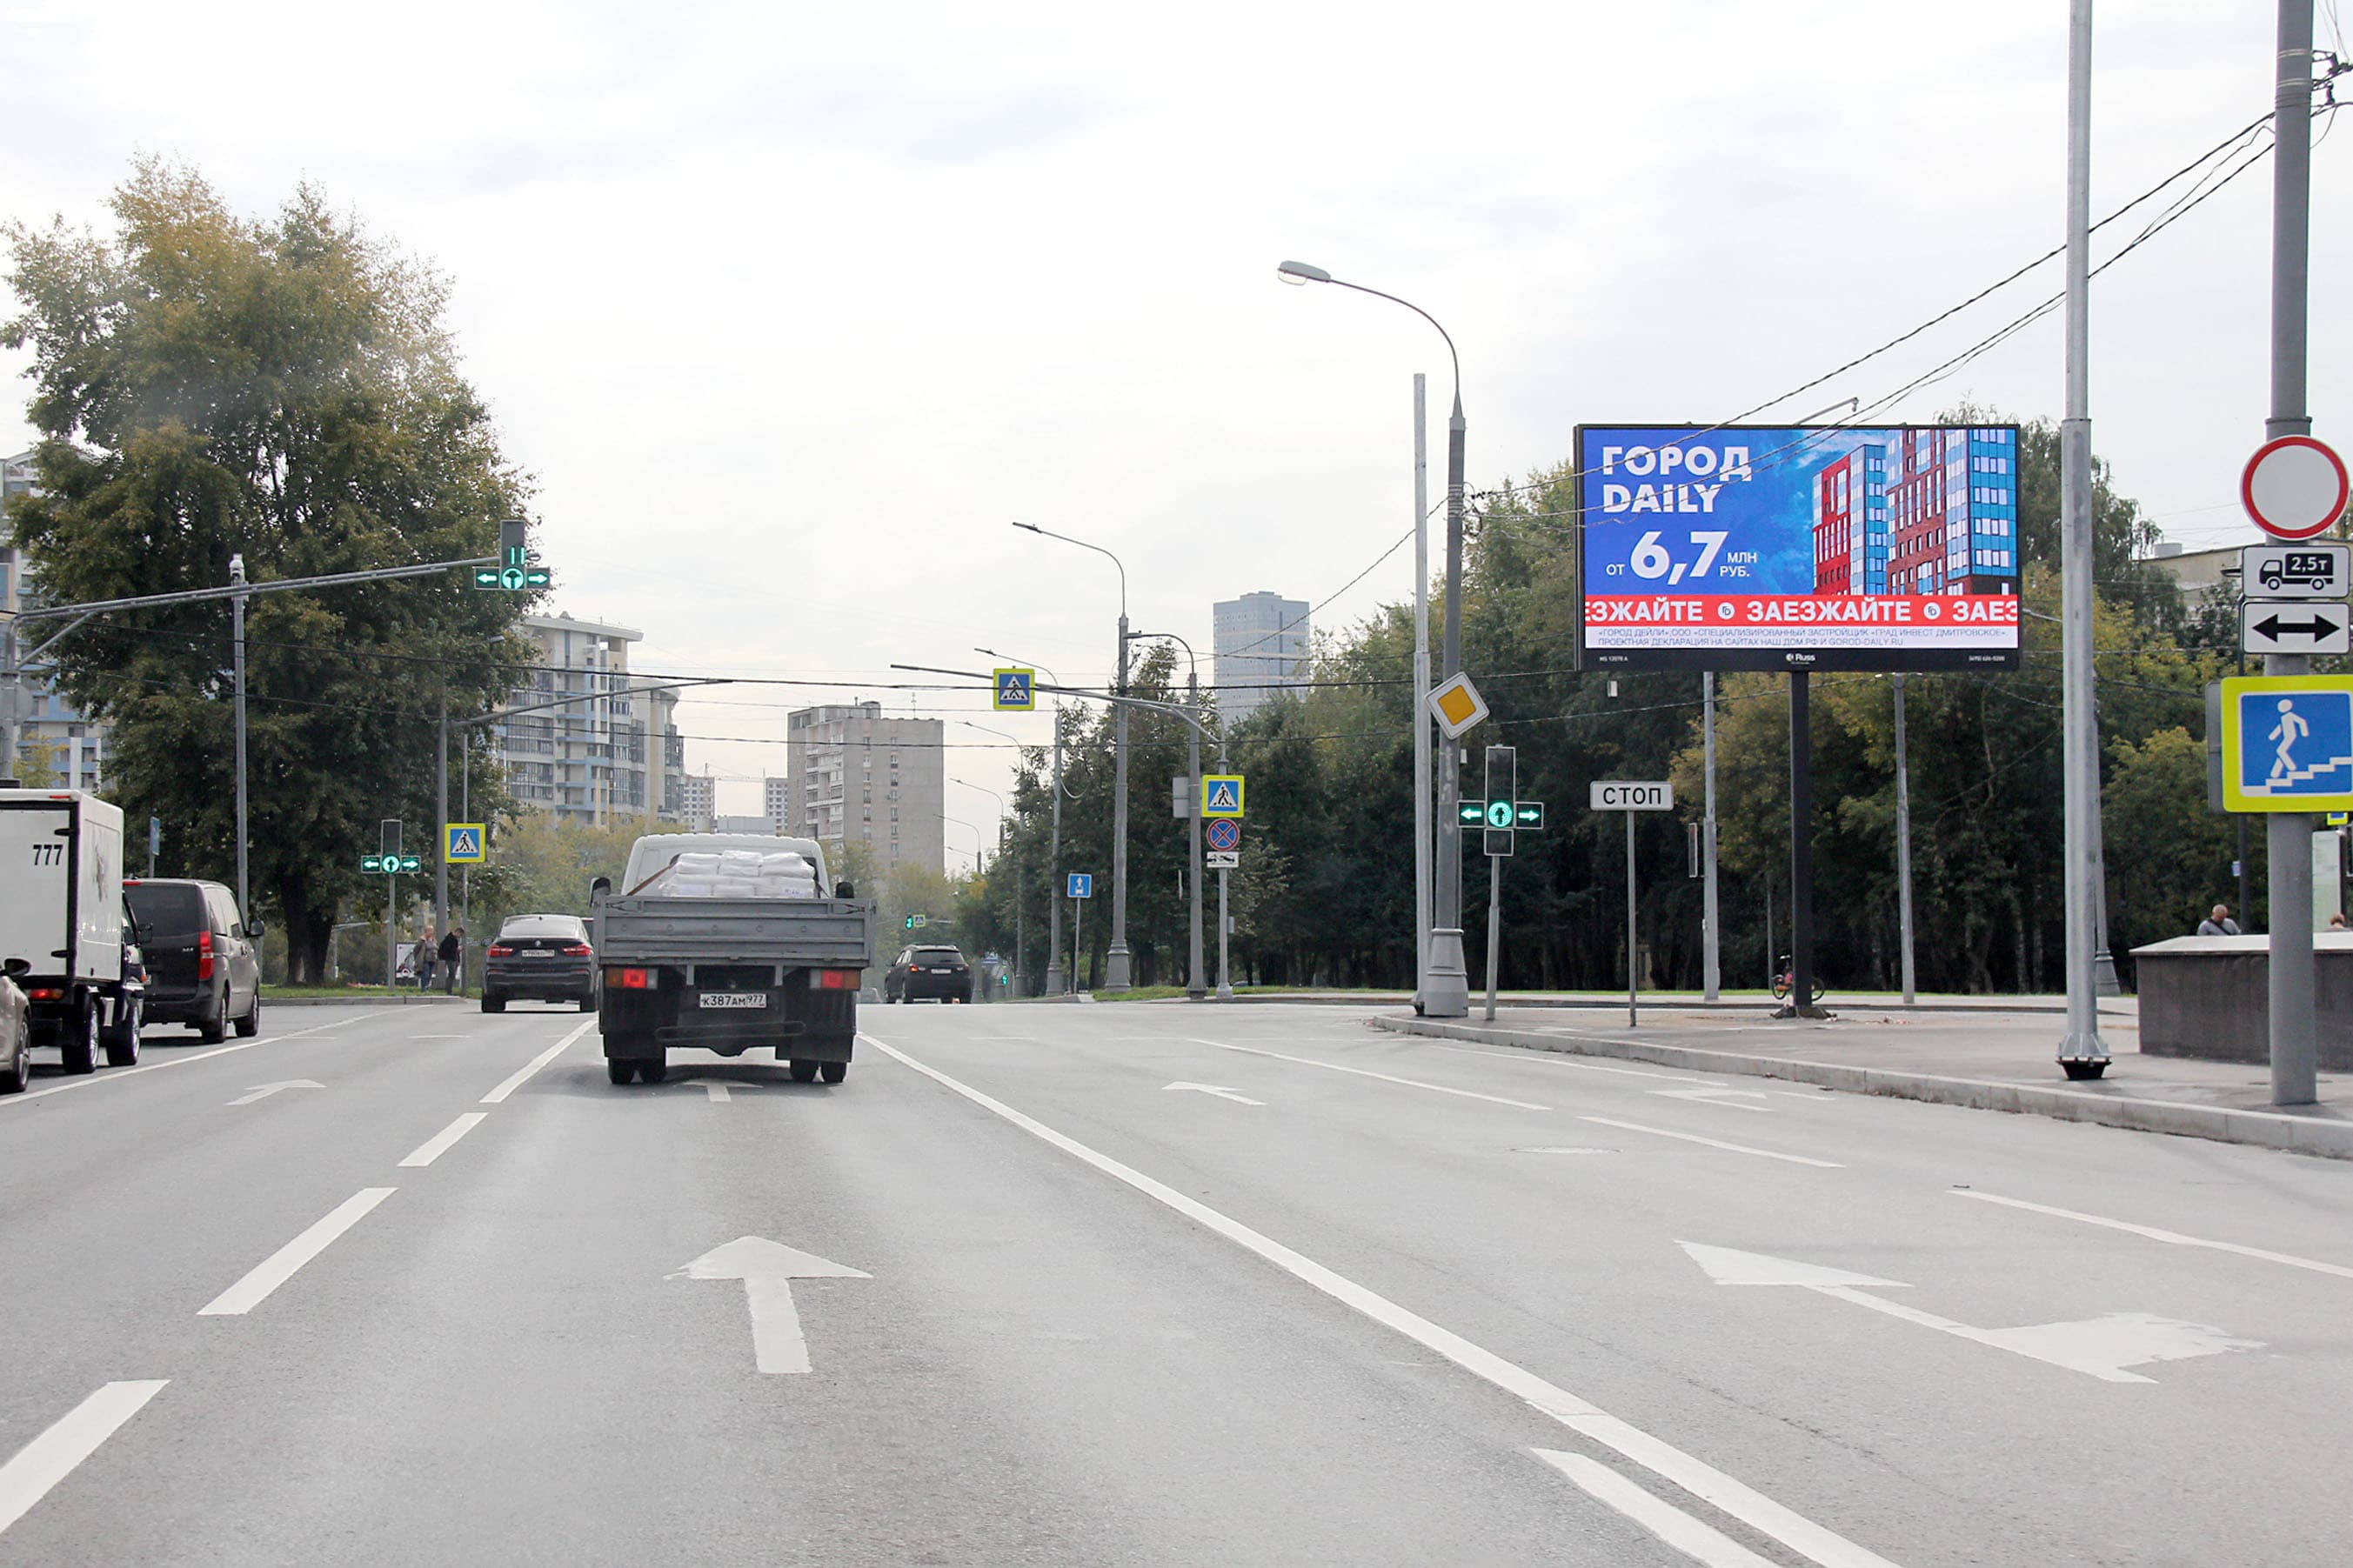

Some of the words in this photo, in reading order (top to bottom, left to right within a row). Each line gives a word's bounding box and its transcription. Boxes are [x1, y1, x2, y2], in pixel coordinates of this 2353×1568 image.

[1602, 445, 1752, 482] ГОРОД
[1603, 484, 1722, 513] DAILY
[1606, 564, 1625, 576] ОТ
[1630, 531, 1729, 585] 6,7
[1727, 552, 1757, 564] МЛН
[1720, 565, 1750, 577] РУБ.
[1747, 597, 1911, 622] ЗАЕЗЖАЙТЕ
[1599, 637, 1649, 646] ПРОЕКТНАЯ
[1651, 637, 1709, 646] ДЕКЛАРАЦИЯ
[1725, 637, 1758, 645] САЙТАХ
[1672, 628, 1691, 637] ООО
[1808, 627, 1868, 637] ЗАСТРОЙЩИК
[1900, 628, 1933, 637] ИНВЕСТ
[1603, 787, 1661, 804] СТОП
[33, 844, 64, 865] 777
